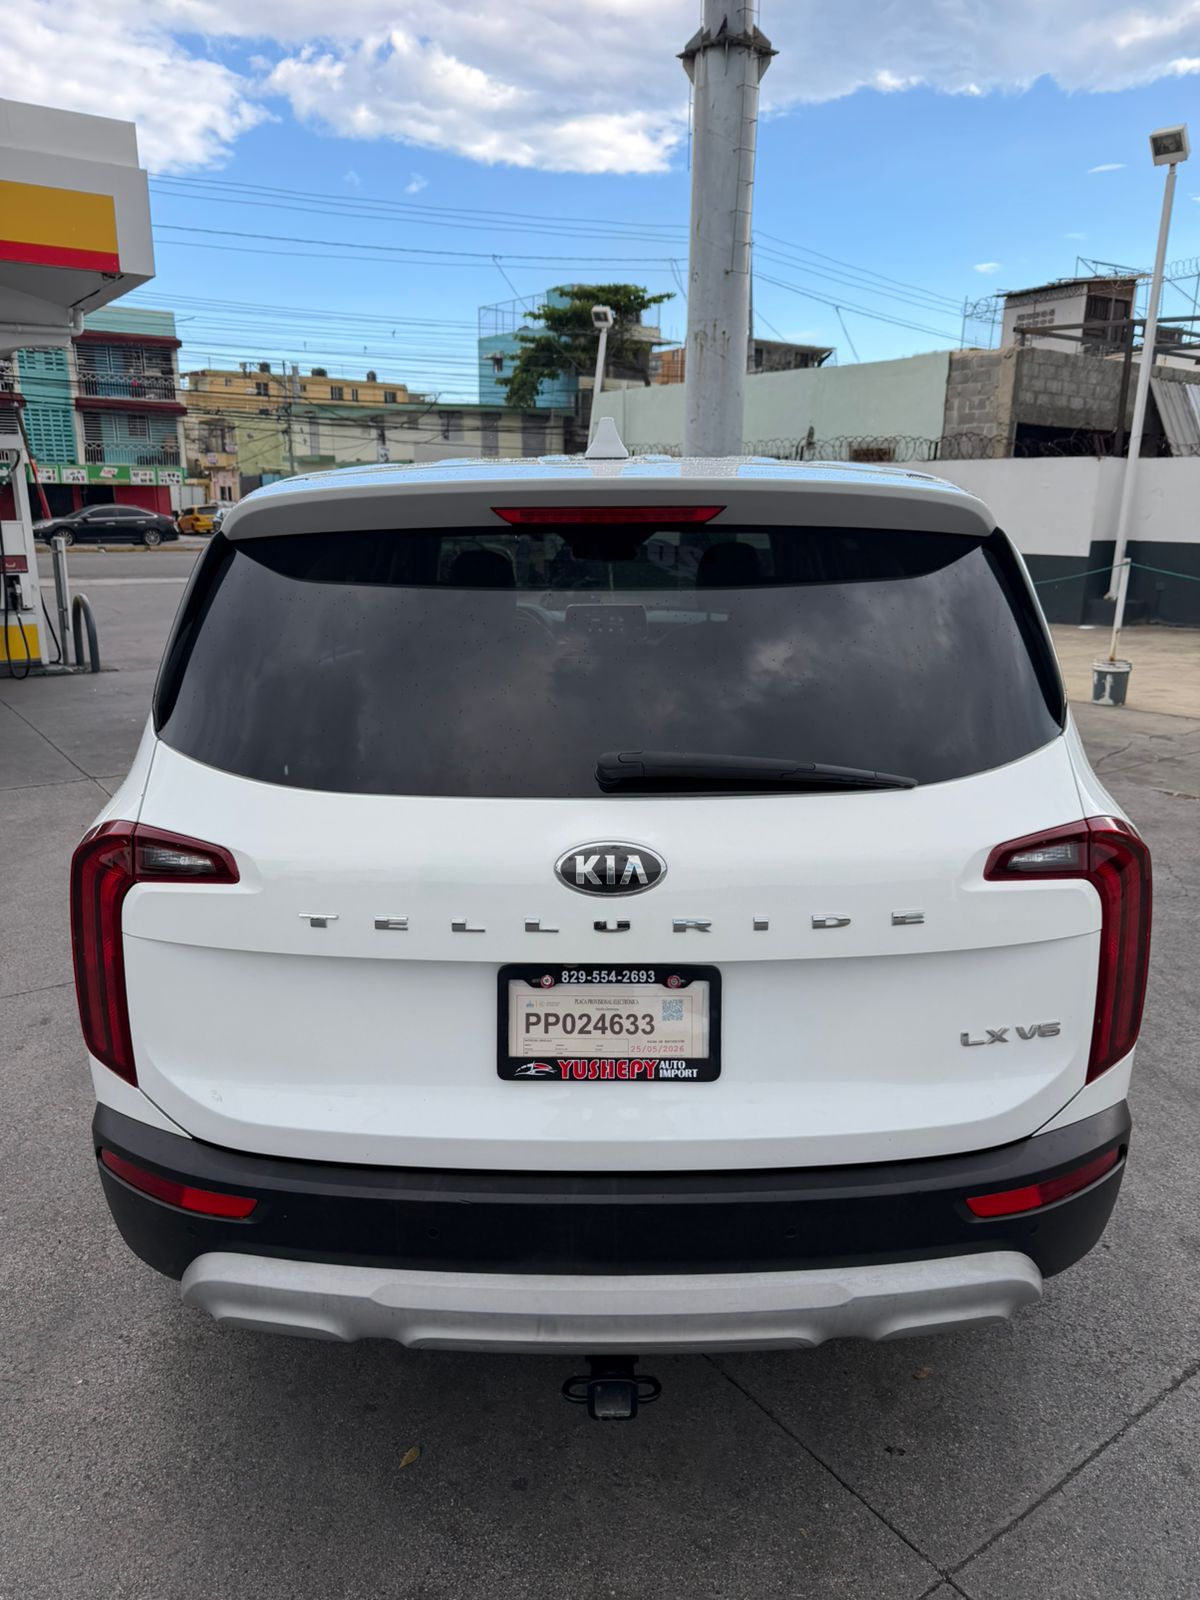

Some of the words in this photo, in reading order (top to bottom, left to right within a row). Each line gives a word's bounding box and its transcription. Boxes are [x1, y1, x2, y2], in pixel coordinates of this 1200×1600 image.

[573, 854, 649, 885] KIA
[298, 910, 925, 933] TELLURIDE
[561, 970, 656, 984] 829-554-2693
[525, 1012, 655, 1035] PP024633
[960, 1028, 1010, 1047] LX
[1015, 1021, 1062, 1041] V6
[630, 1045, 685, 1054] 25/05/2026
[557, 1059, 659, 1079] YUSHEPY
[659, 1060, 686, 1069] AUTO
[659, 1069, 698, 1078] IMPORT
